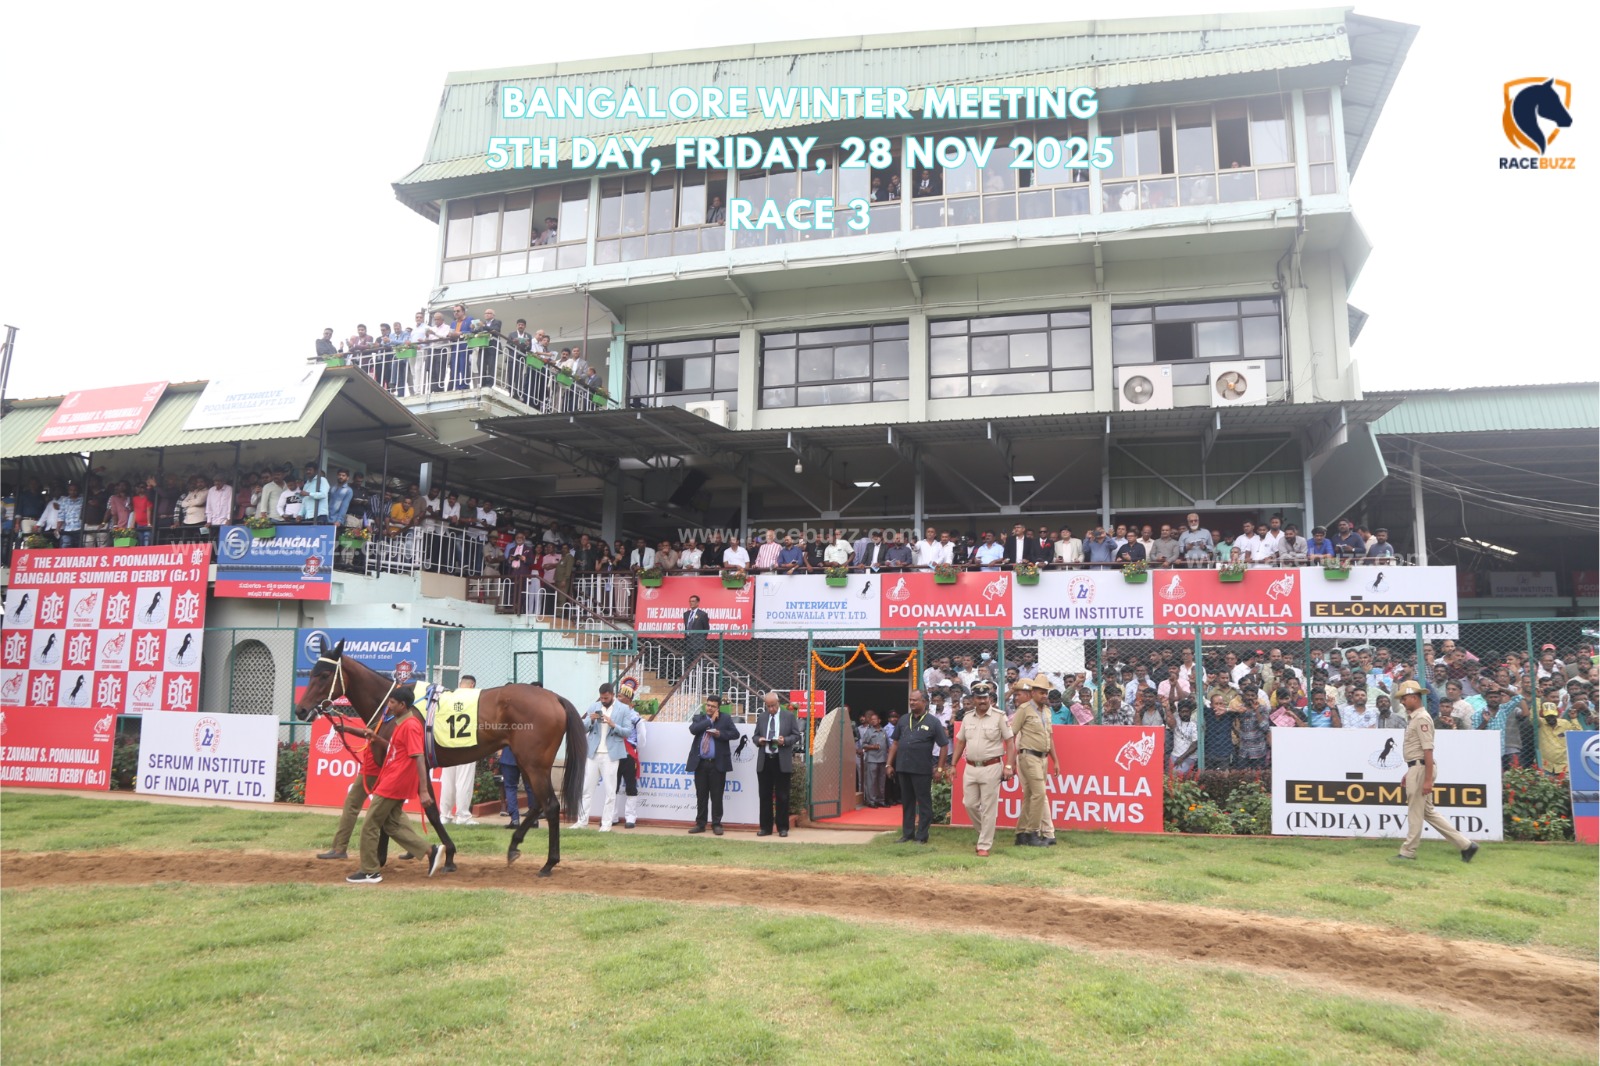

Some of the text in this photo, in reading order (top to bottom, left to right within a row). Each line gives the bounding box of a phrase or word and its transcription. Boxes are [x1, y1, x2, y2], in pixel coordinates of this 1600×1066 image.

[34, 553, 183, 569] THE ZAVARAY S. POONAWALLA
[14, 568, 200, 584] BANGALORE SUMMER DERBY (Gr.1)
[786, 601, 848, 609] INTERVALVE
[888, 604, 1006, 617] POONAWALLA
[1162, 603, 1293, 618] POONAWALLA
[1315, 603, 1444, 616] EL-O-MATIC
[647, 608, 658, 619] THE
[766, 611, 868, 620] POONAWALLA PVT. LTD.
[1023, 606, 1144, 620] SERUM INSTITUTE
[917, 621, 976, 634] GROUP
[1020, 625, 1038, 637] OF
[1042, 625, 1079, 637] INDIA
[1222, 621, 1288, 636] FARMS
[446, 713, 471, 739] 12
[6, 746, 40, 762] ZAVARAY
[40, 747, 47, 763] S.
[49, 748, 100, 764] POONAWALLA
[149, 753, 266, 775] SERUM INSTITUTE
[25, 766, 59, 783] SUMMER
[59, 768, 85, 783] DERBY
[85, 769, 106, 786] (Gr.1)
[144, 775, 266, 797] OF INDIA PVT. LTD.
[725, 780, 743, 793] TD.
[1294, 783, 1482, 806] EL-O-MTIC
[636, 798, 650, 808] The
[1052, 800, 1144, 824] FARMS
[1286, 811, 1489, 833] (INDIA) PV. TD.
